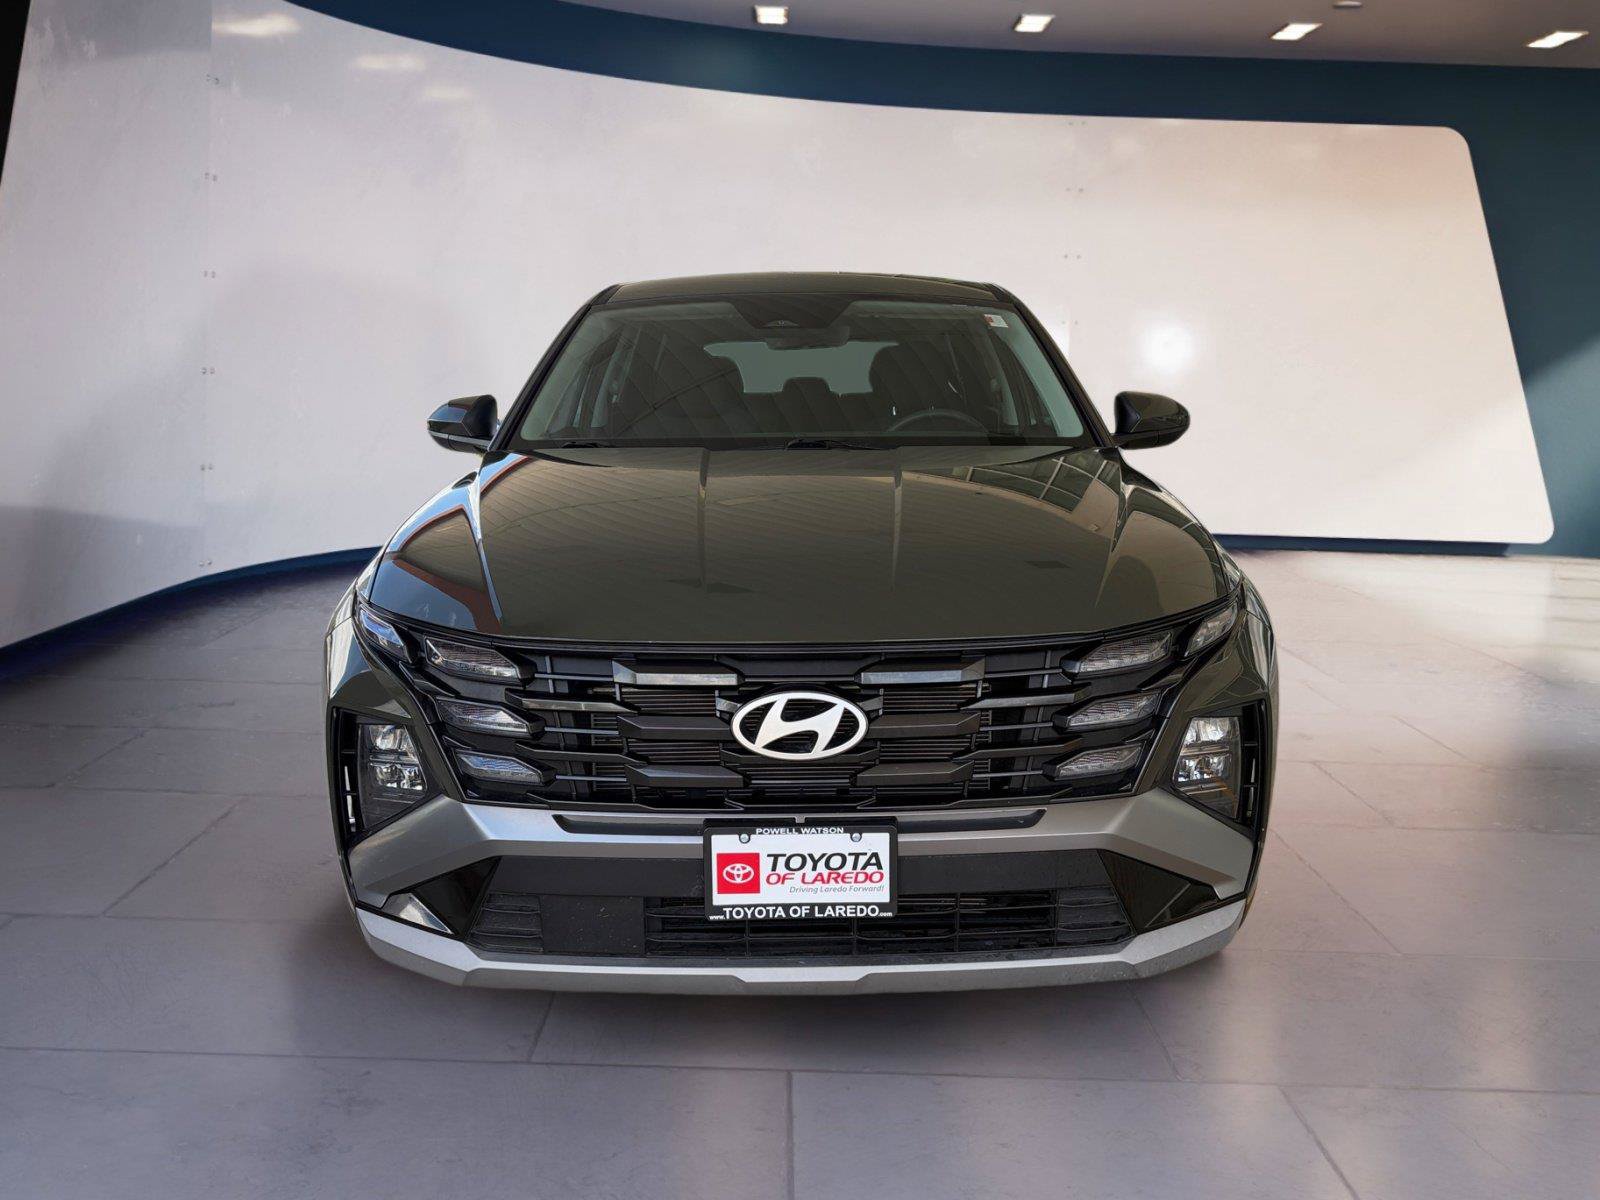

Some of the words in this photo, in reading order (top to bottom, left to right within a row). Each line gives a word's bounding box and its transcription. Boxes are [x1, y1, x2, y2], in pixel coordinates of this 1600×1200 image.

[766, 852, 884, 872] TOYOTA
[765, 873, 795, 885] OF
[801, 871, 885, 885] LAREDO
[789, 886, 819, 894] Driving
[849, 885, 885, 893] Forward!
[789, 905, 811, 918] OF
